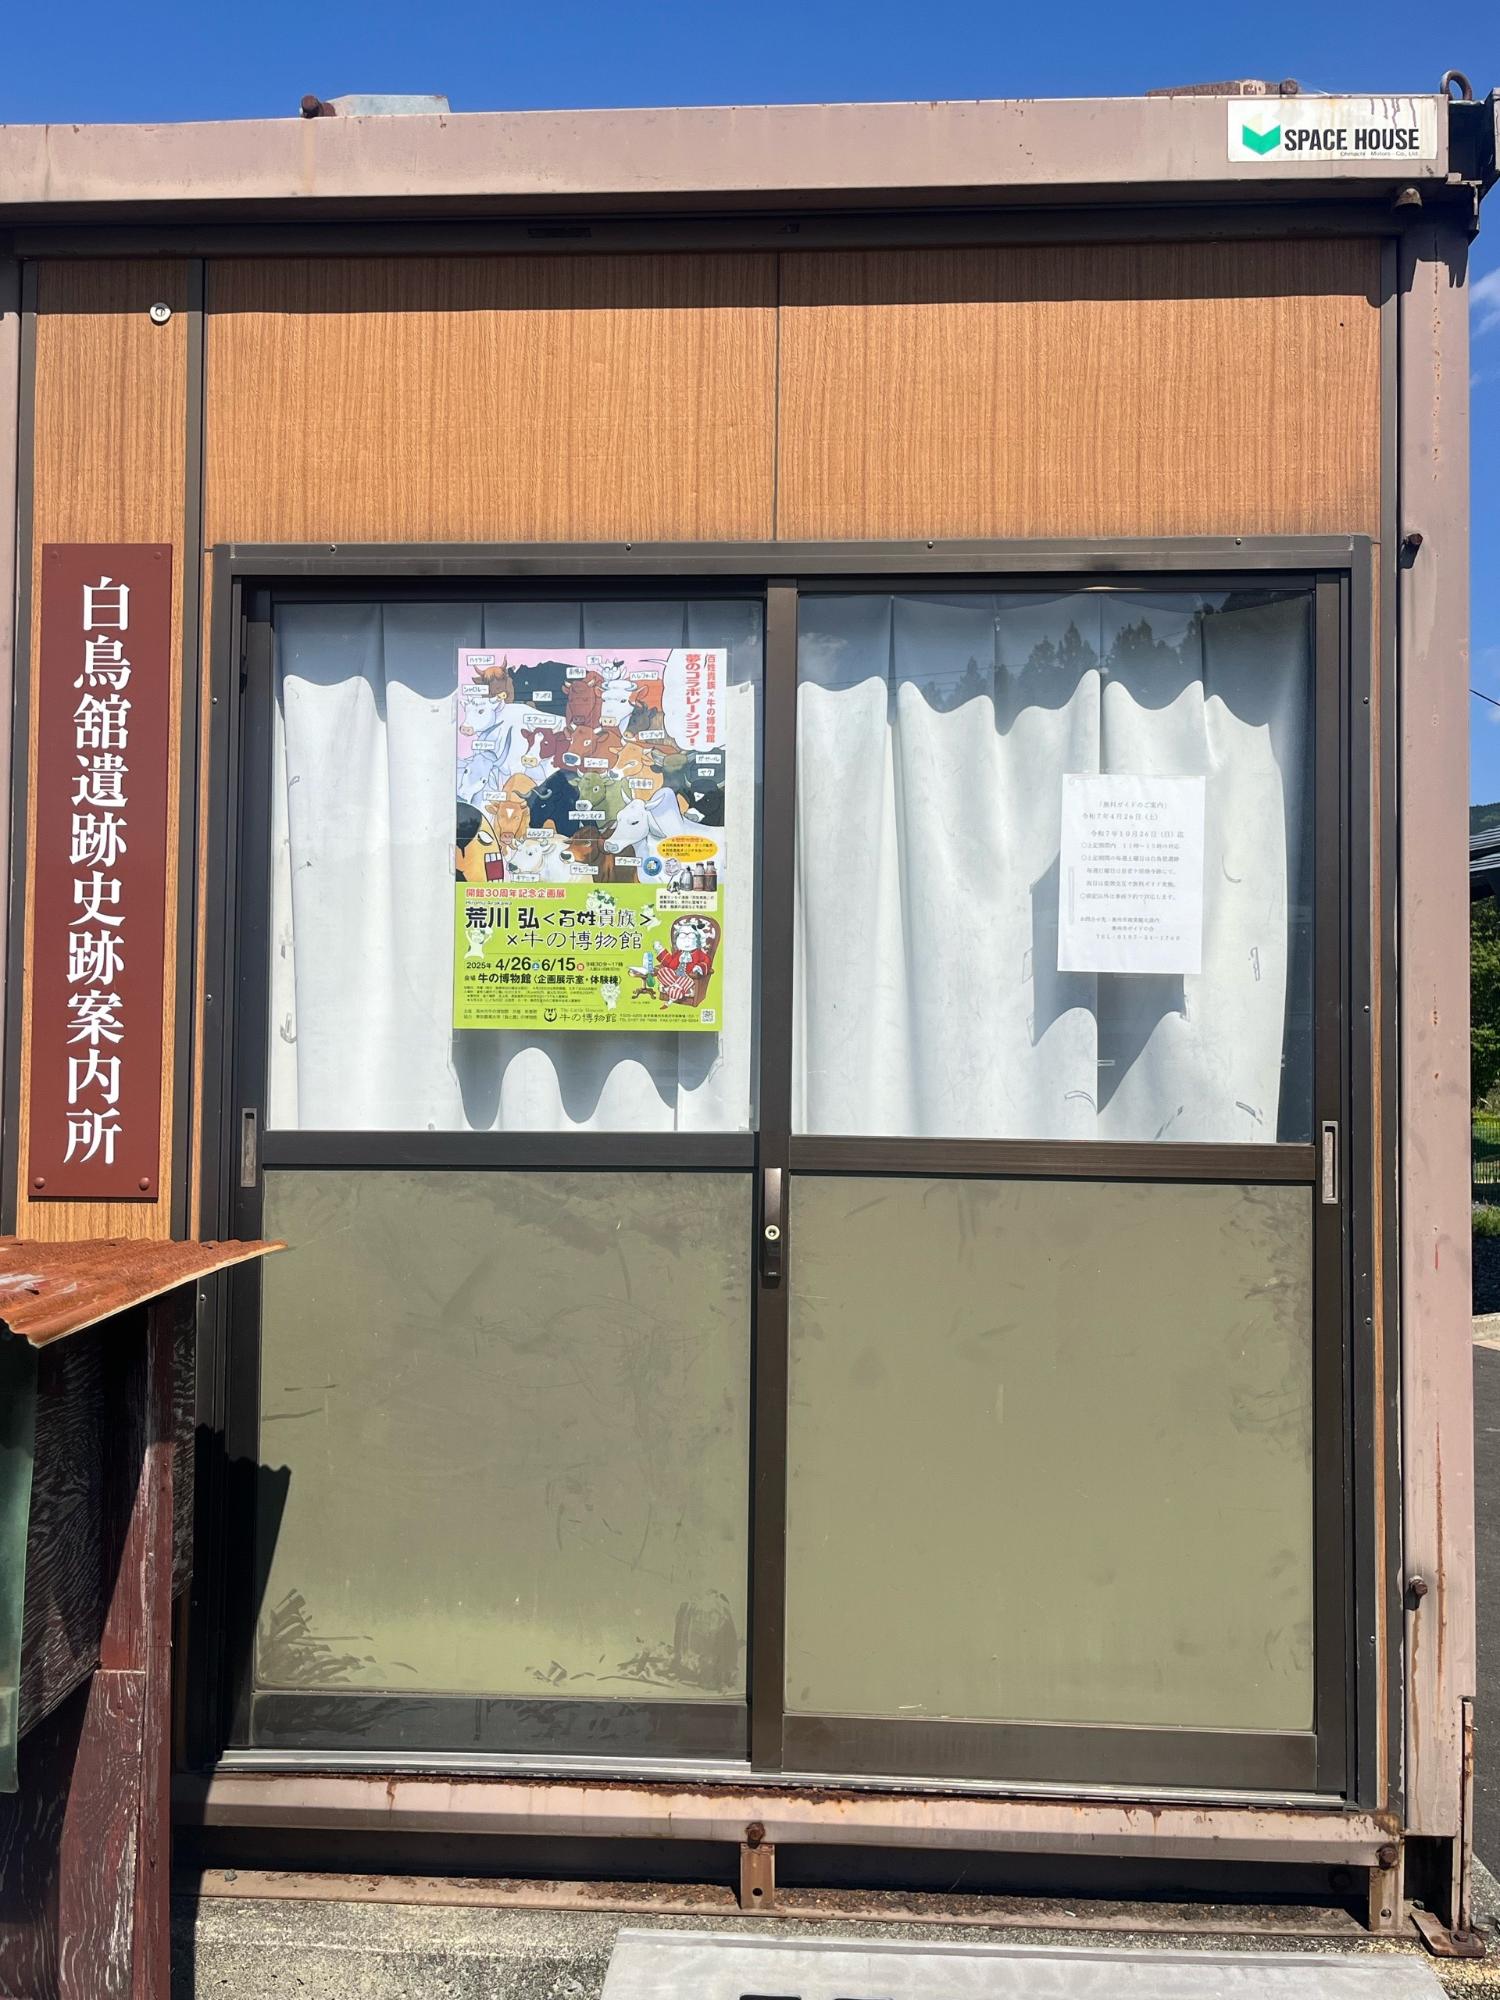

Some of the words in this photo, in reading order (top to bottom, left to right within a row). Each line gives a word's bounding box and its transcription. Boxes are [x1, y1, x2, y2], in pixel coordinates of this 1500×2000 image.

[1284, 128, 1347, 151] SPACE
[1355, 128, 1420, 150] HOUSE
[686, 654, 700, 746] 夢のコラボレーション!
[63, 576, 132, 1165] 白鳥舘遺跡史跡案内所
[466, 888, 566, 898] 開館30周年記念企画展
[465, 907, 509, 929] 荒川
[507, 931, 642, 950] ×牛の博物館
[495, 957, 531, 971] 4/26
[541, 957, 575, 971] 6/15
[559, 1013, 616, 1023] 牛の博物館
